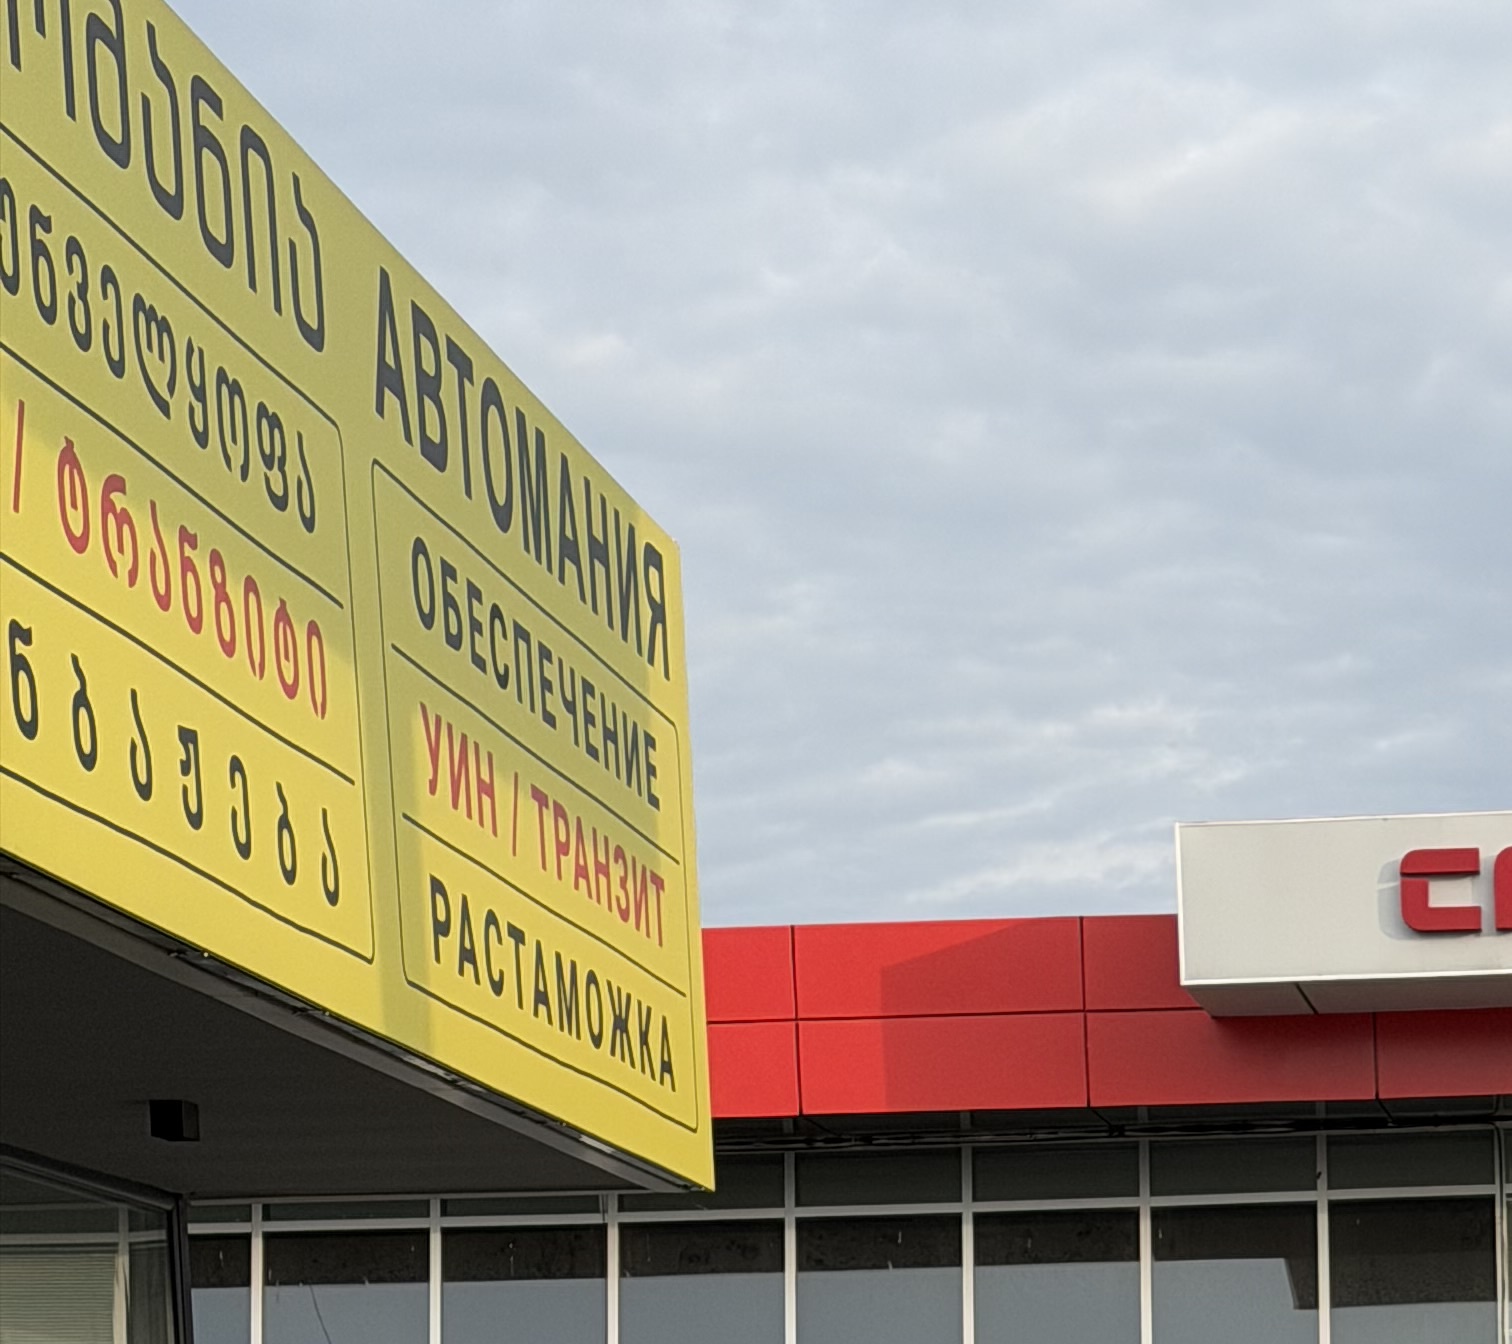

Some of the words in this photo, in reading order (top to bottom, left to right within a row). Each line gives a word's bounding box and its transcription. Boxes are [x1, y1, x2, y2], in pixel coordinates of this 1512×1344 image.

[57, 436, 328, 720] ტრანზიტი
[375, 266, 671, 682] АВТОМАНИЯ
[411, 536, 660, 811] ОБЕСПЕЧЕНИЕ
[419, 702, 498, 838] УИН
[531, 780, 665, 947] ТРАНЗИТ
[429, 873, 677, 1093] РАСТАМОЖКА
